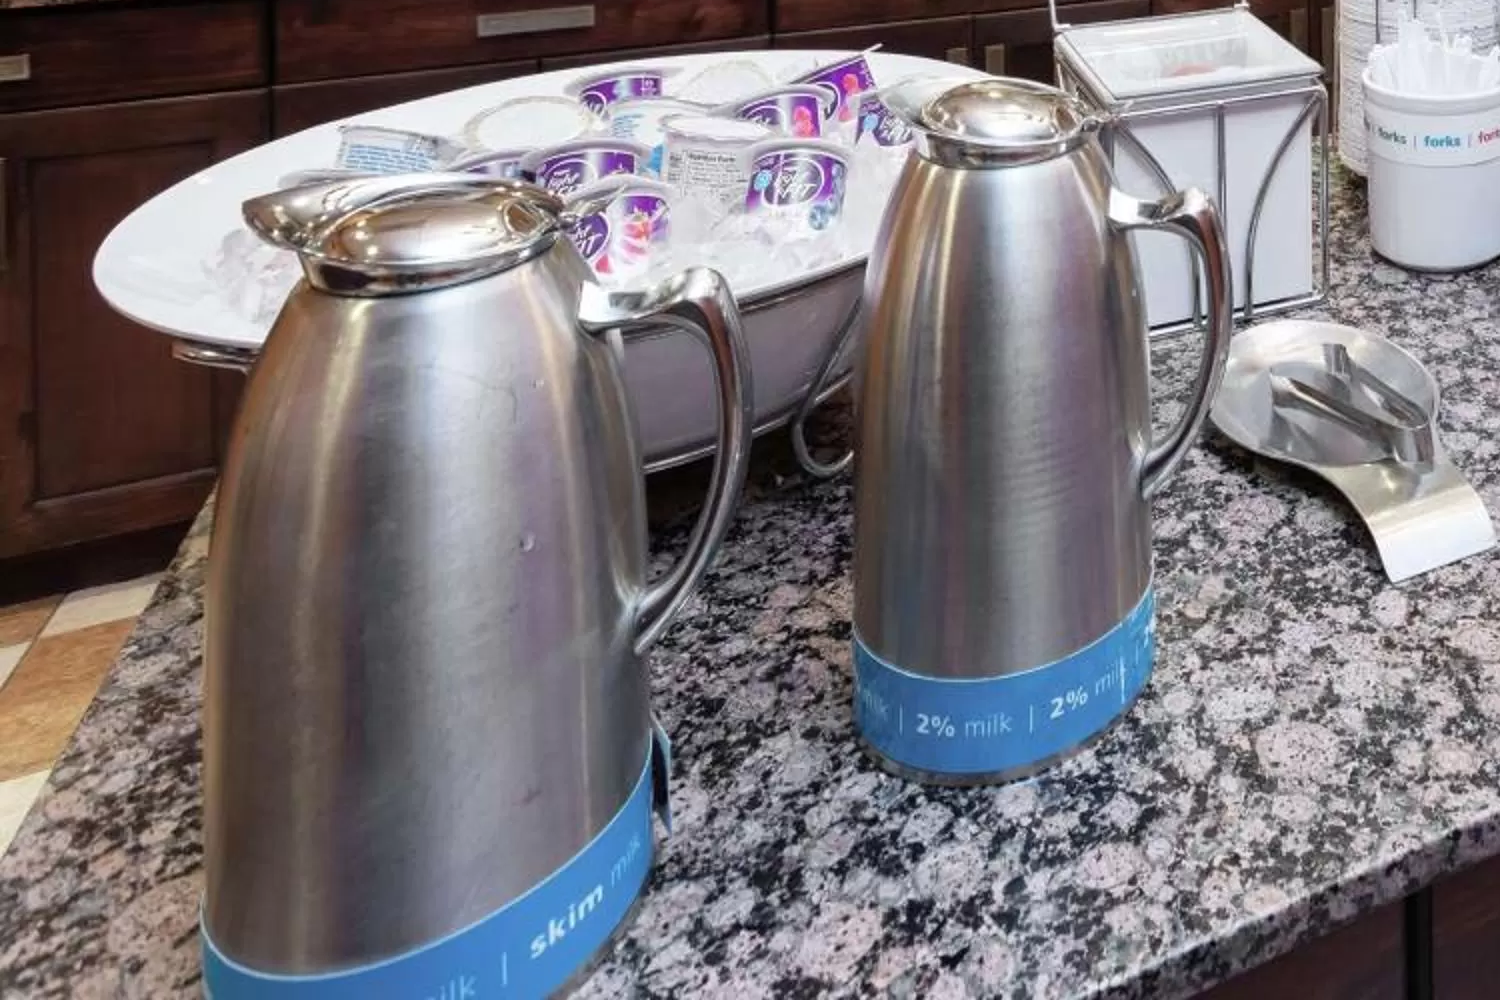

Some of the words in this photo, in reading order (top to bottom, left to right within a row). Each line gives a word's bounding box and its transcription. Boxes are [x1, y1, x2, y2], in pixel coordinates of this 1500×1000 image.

[1377, 126, 1407, 145] forks
[1423, 134, 1461, 148] forks
[1050, 687, 1088, 720] 2%
[916, 713, 956, 738] 2%
[964, 712, 1013, 738] milk
[530, 885, 603, 960] skim
[610, 832, 642, 887] milk
[424, 975, 477, 1000] ilk
